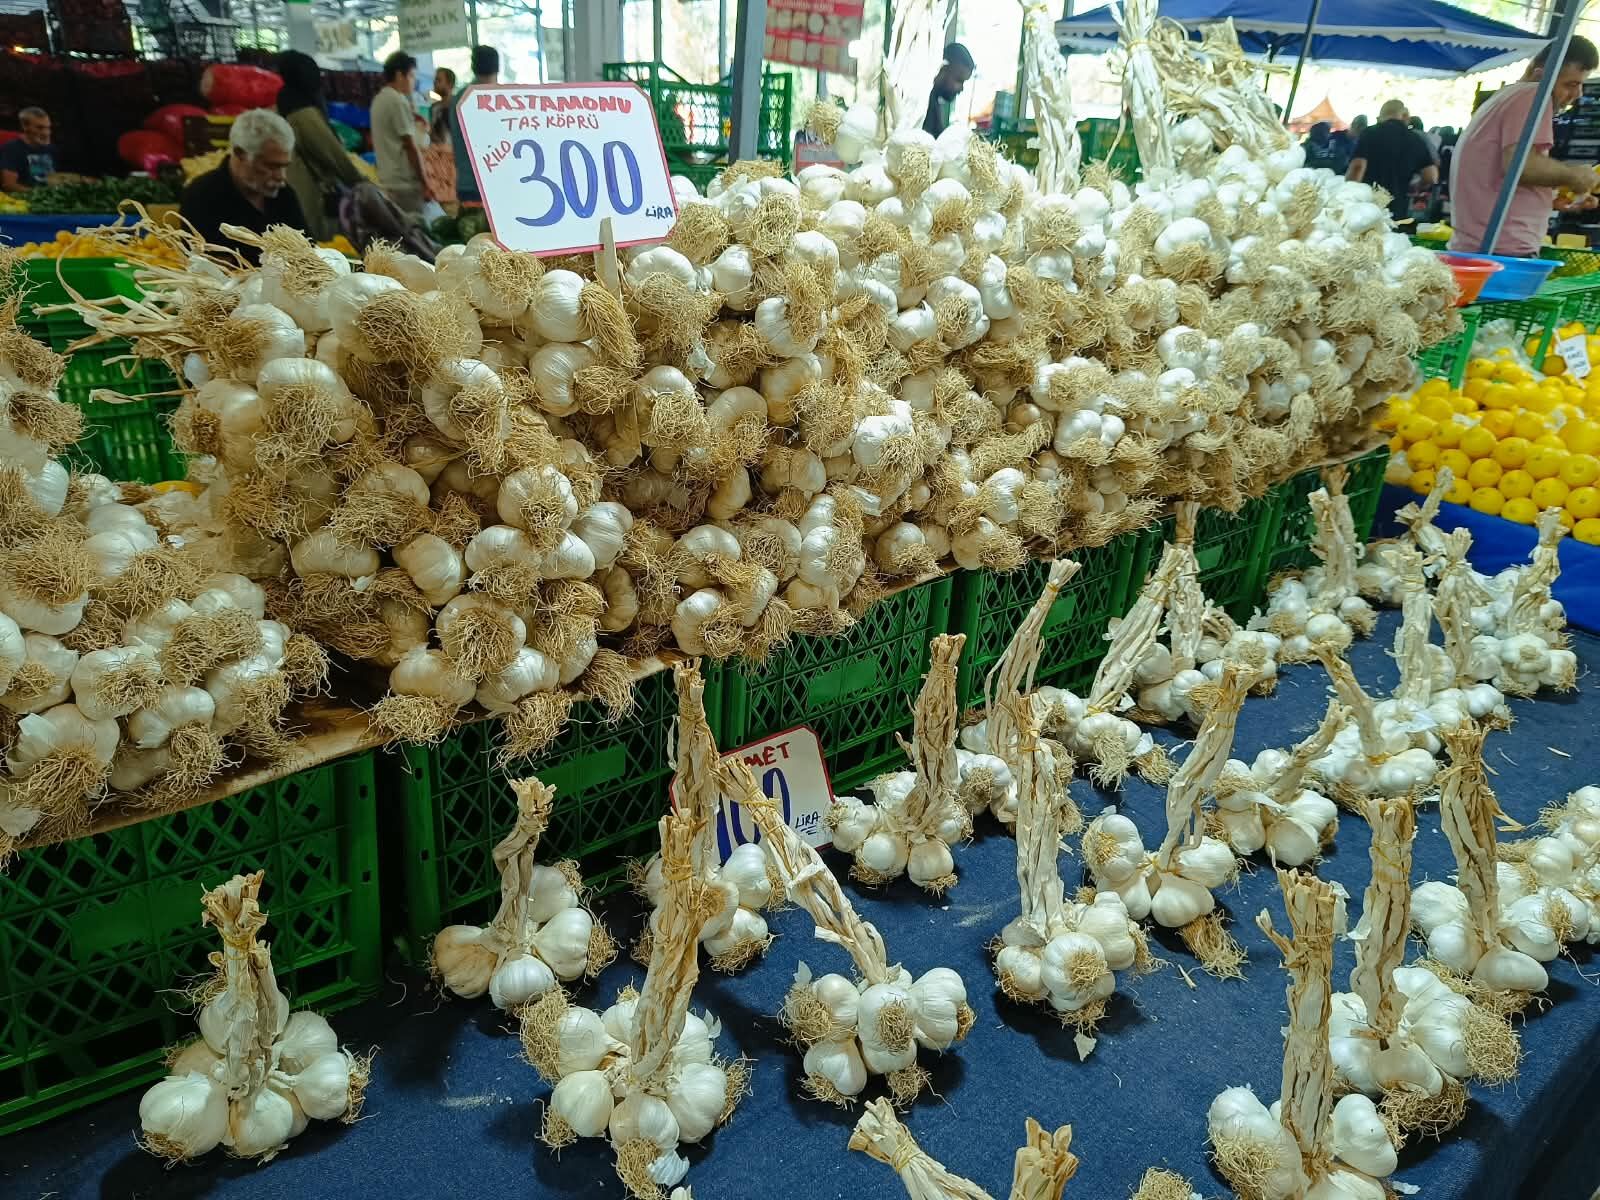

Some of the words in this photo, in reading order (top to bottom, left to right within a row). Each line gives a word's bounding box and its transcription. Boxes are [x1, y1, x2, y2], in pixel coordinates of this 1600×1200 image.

[477, 94, 632, 114] KASTAMONU
[501, 116, 541, 131] TAŞ
[546, 114, 600, 130] KÖPRÜ
[482, 140, 512, 173] KİLO
[512, 139, 644, 227] 300
[645, 207, 674, 220] LİRA
[743, 741, 791, 768] MET
[795, 810, 822, 829] LİRA
